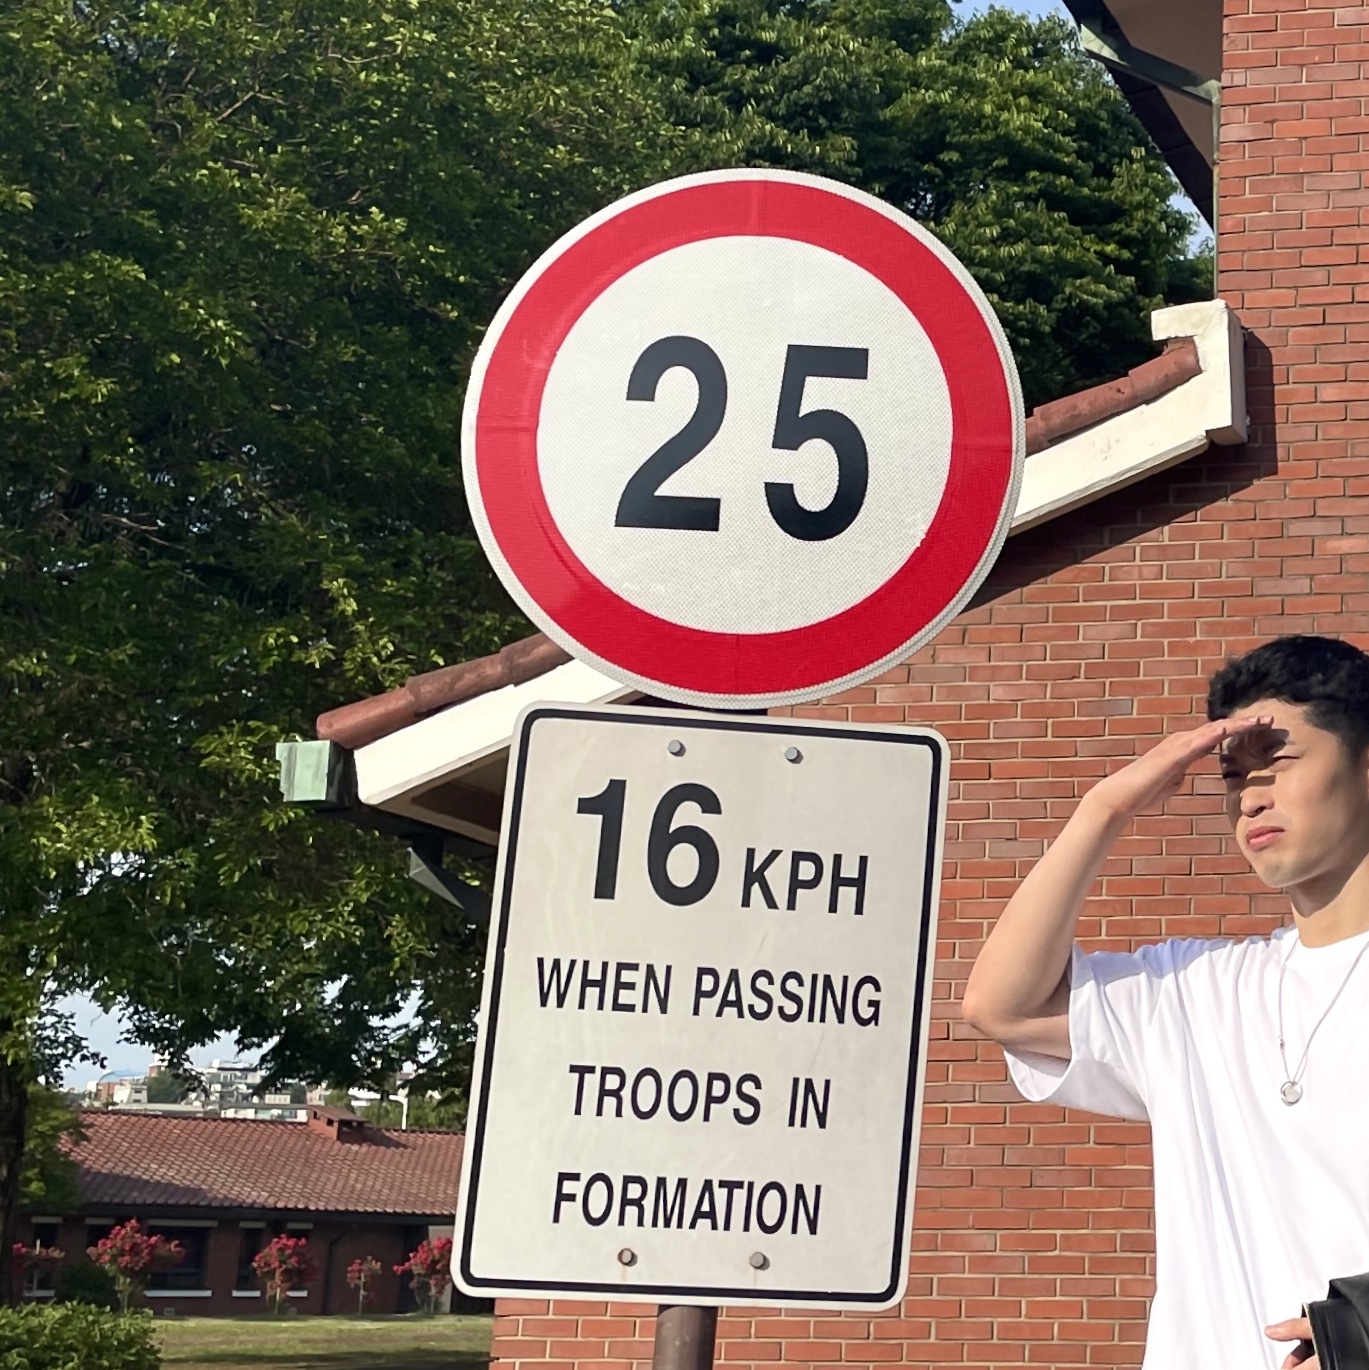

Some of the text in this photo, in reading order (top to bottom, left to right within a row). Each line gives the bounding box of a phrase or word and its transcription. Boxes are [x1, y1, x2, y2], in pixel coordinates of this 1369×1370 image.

[614, 335, 869, 542] 25
[576, 778, 869, 916] 16 KPH
[537, 957, 882, 1027] WHEN PASSING
[569, 1064, 831, 1129] TROOPS IN
[552, 1171, 822, 1236] FORMATION
